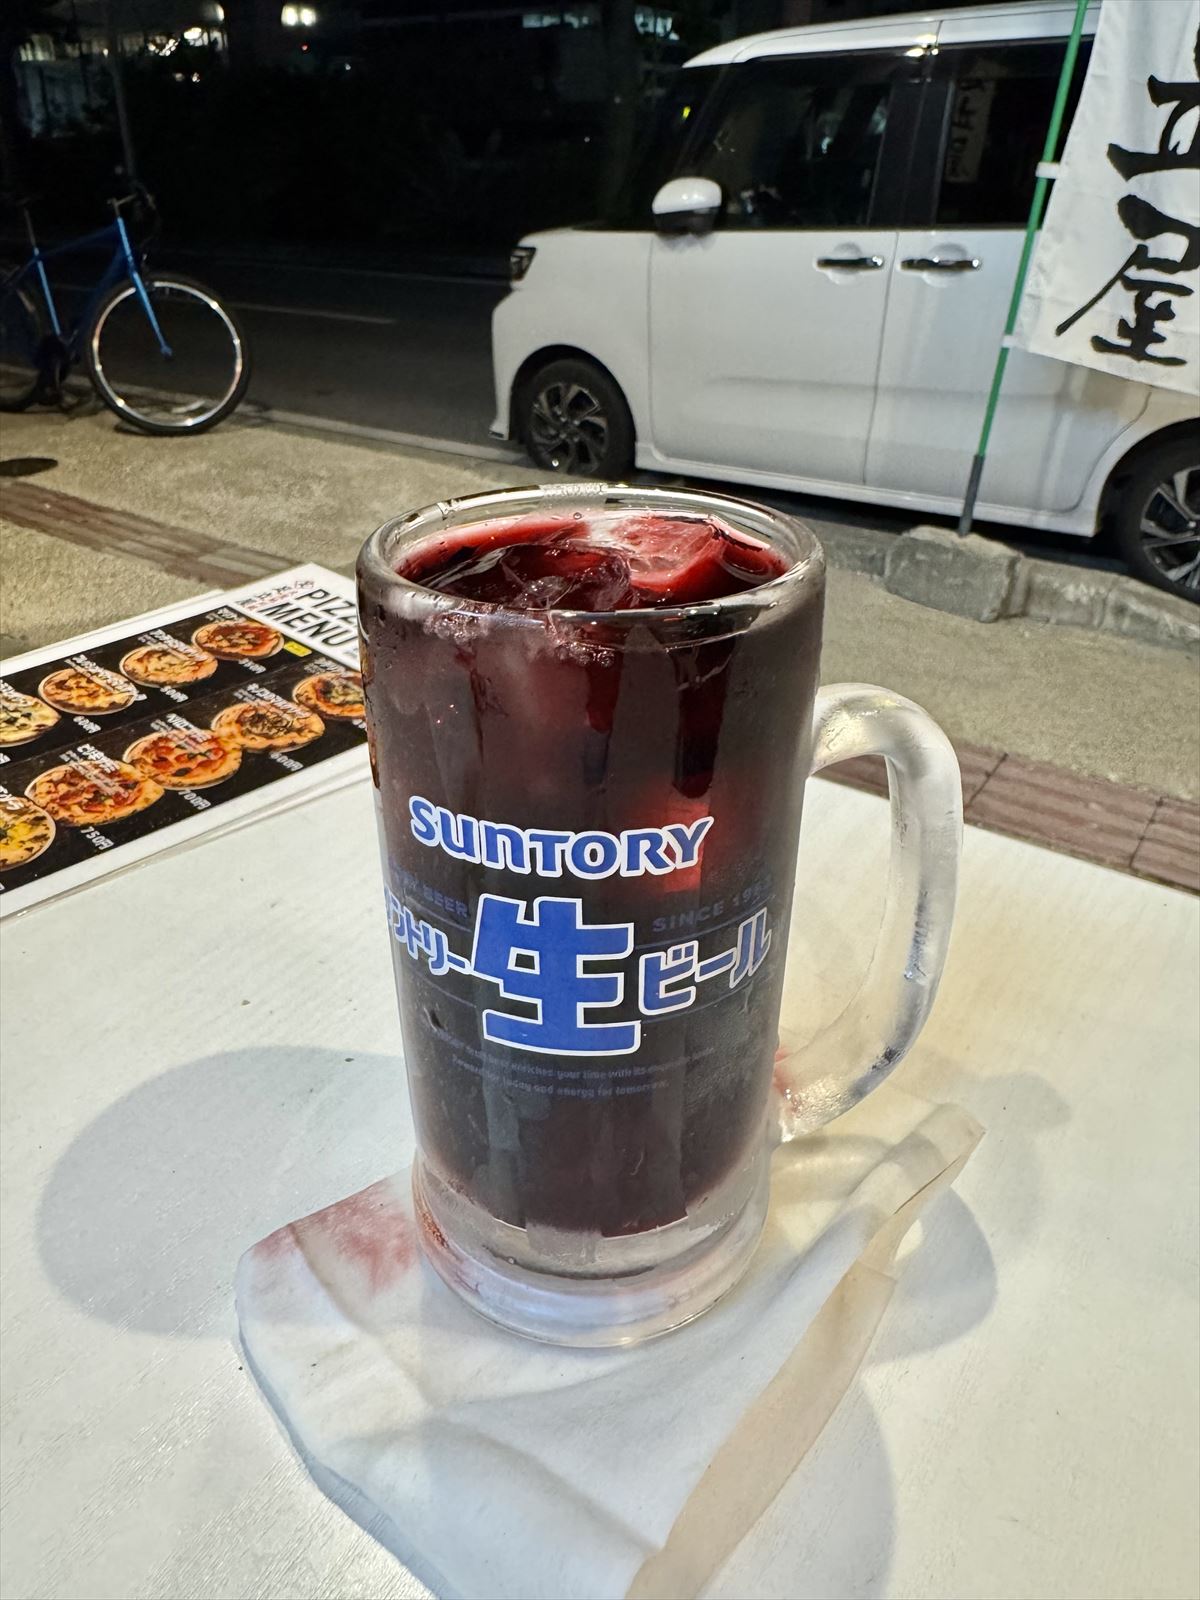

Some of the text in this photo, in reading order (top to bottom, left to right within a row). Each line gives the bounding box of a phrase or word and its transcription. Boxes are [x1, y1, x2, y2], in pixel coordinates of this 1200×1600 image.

[258, 602, 358, 646] MENU
[295, 588, 357, 627] PIZZ
[178, 789, 212, 811] 700円
[81, 826, 115, 850] 750円
[408, 795, 715, 880] SUNTORY
[652, 900, 725, 933] SINCE
